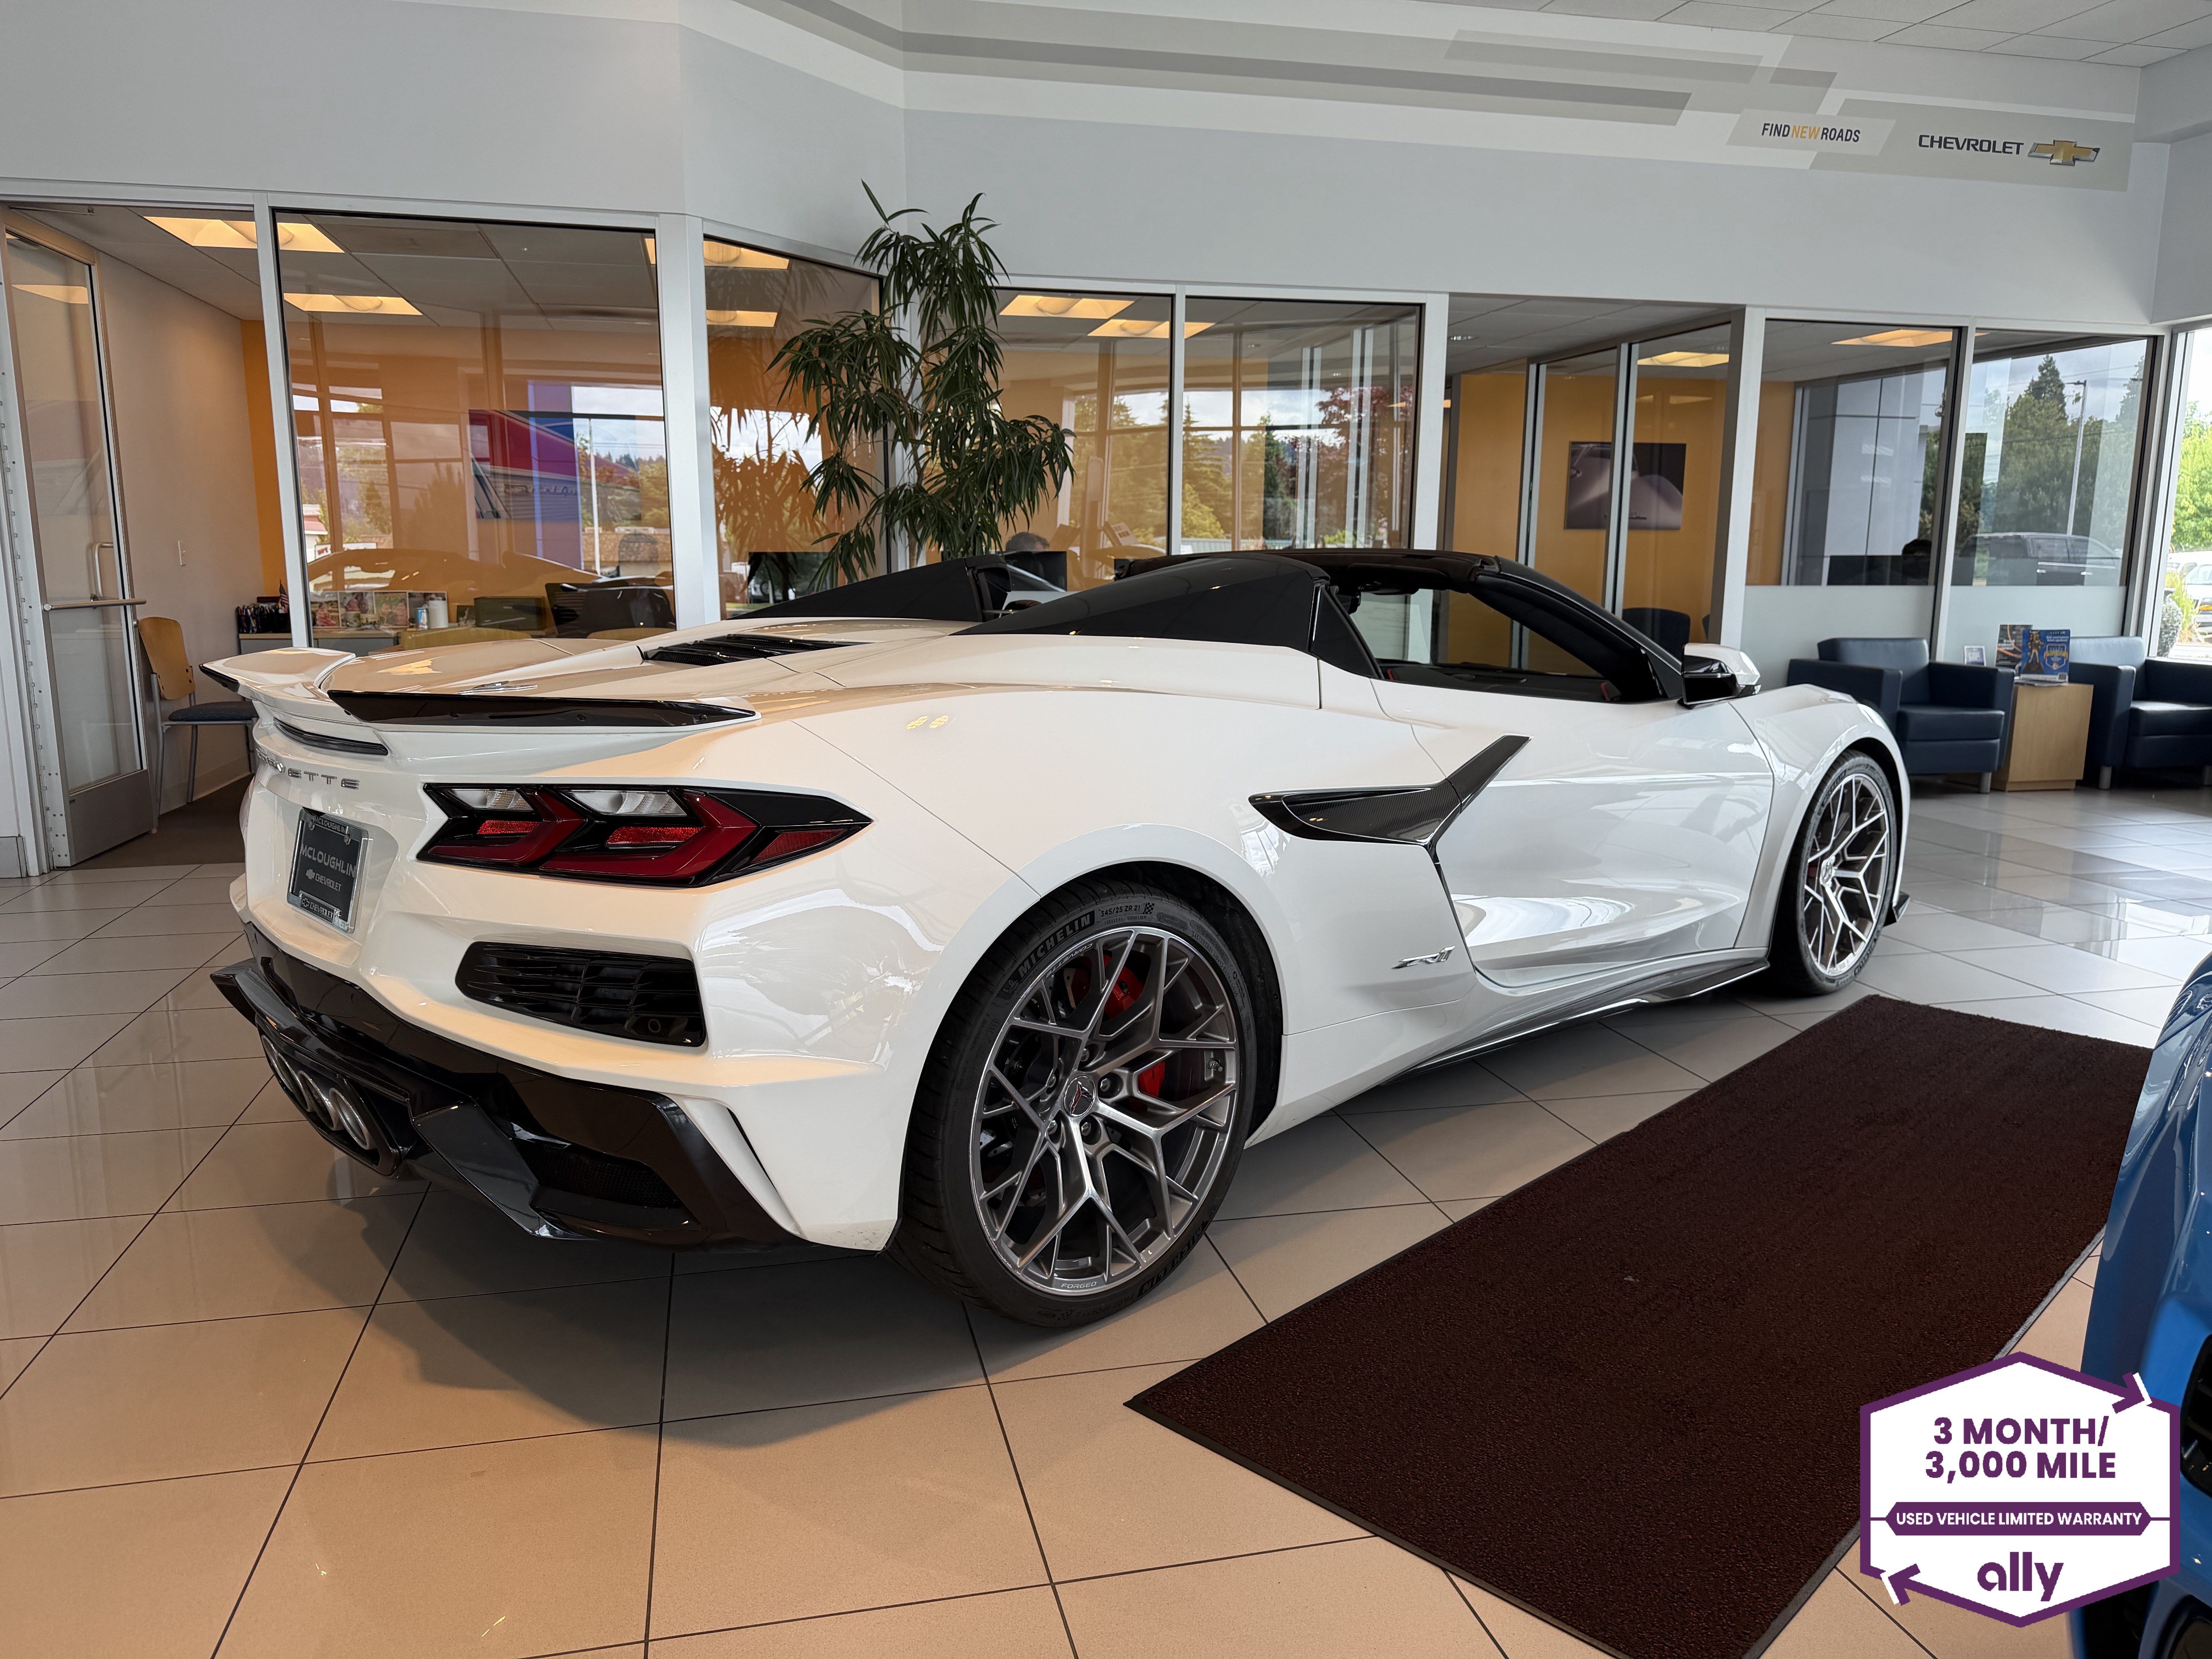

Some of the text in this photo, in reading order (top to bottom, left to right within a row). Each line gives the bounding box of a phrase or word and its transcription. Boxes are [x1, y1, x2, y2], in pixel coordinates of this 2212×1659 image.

[1761, 122, 1861, 143] FIND NEW ROADS
[1918, 134, 2024, 155] CHEVROLET
[299, 843, 357, 878] MCLOUGHLIN
[315, 873, 342, 892] CHEVROLET
[1100, 905, 1123, 917] 345/25
[1018, 914, 1092, 978] MICHELIN
[1061, 1281, 1097, 1290] FORGED
